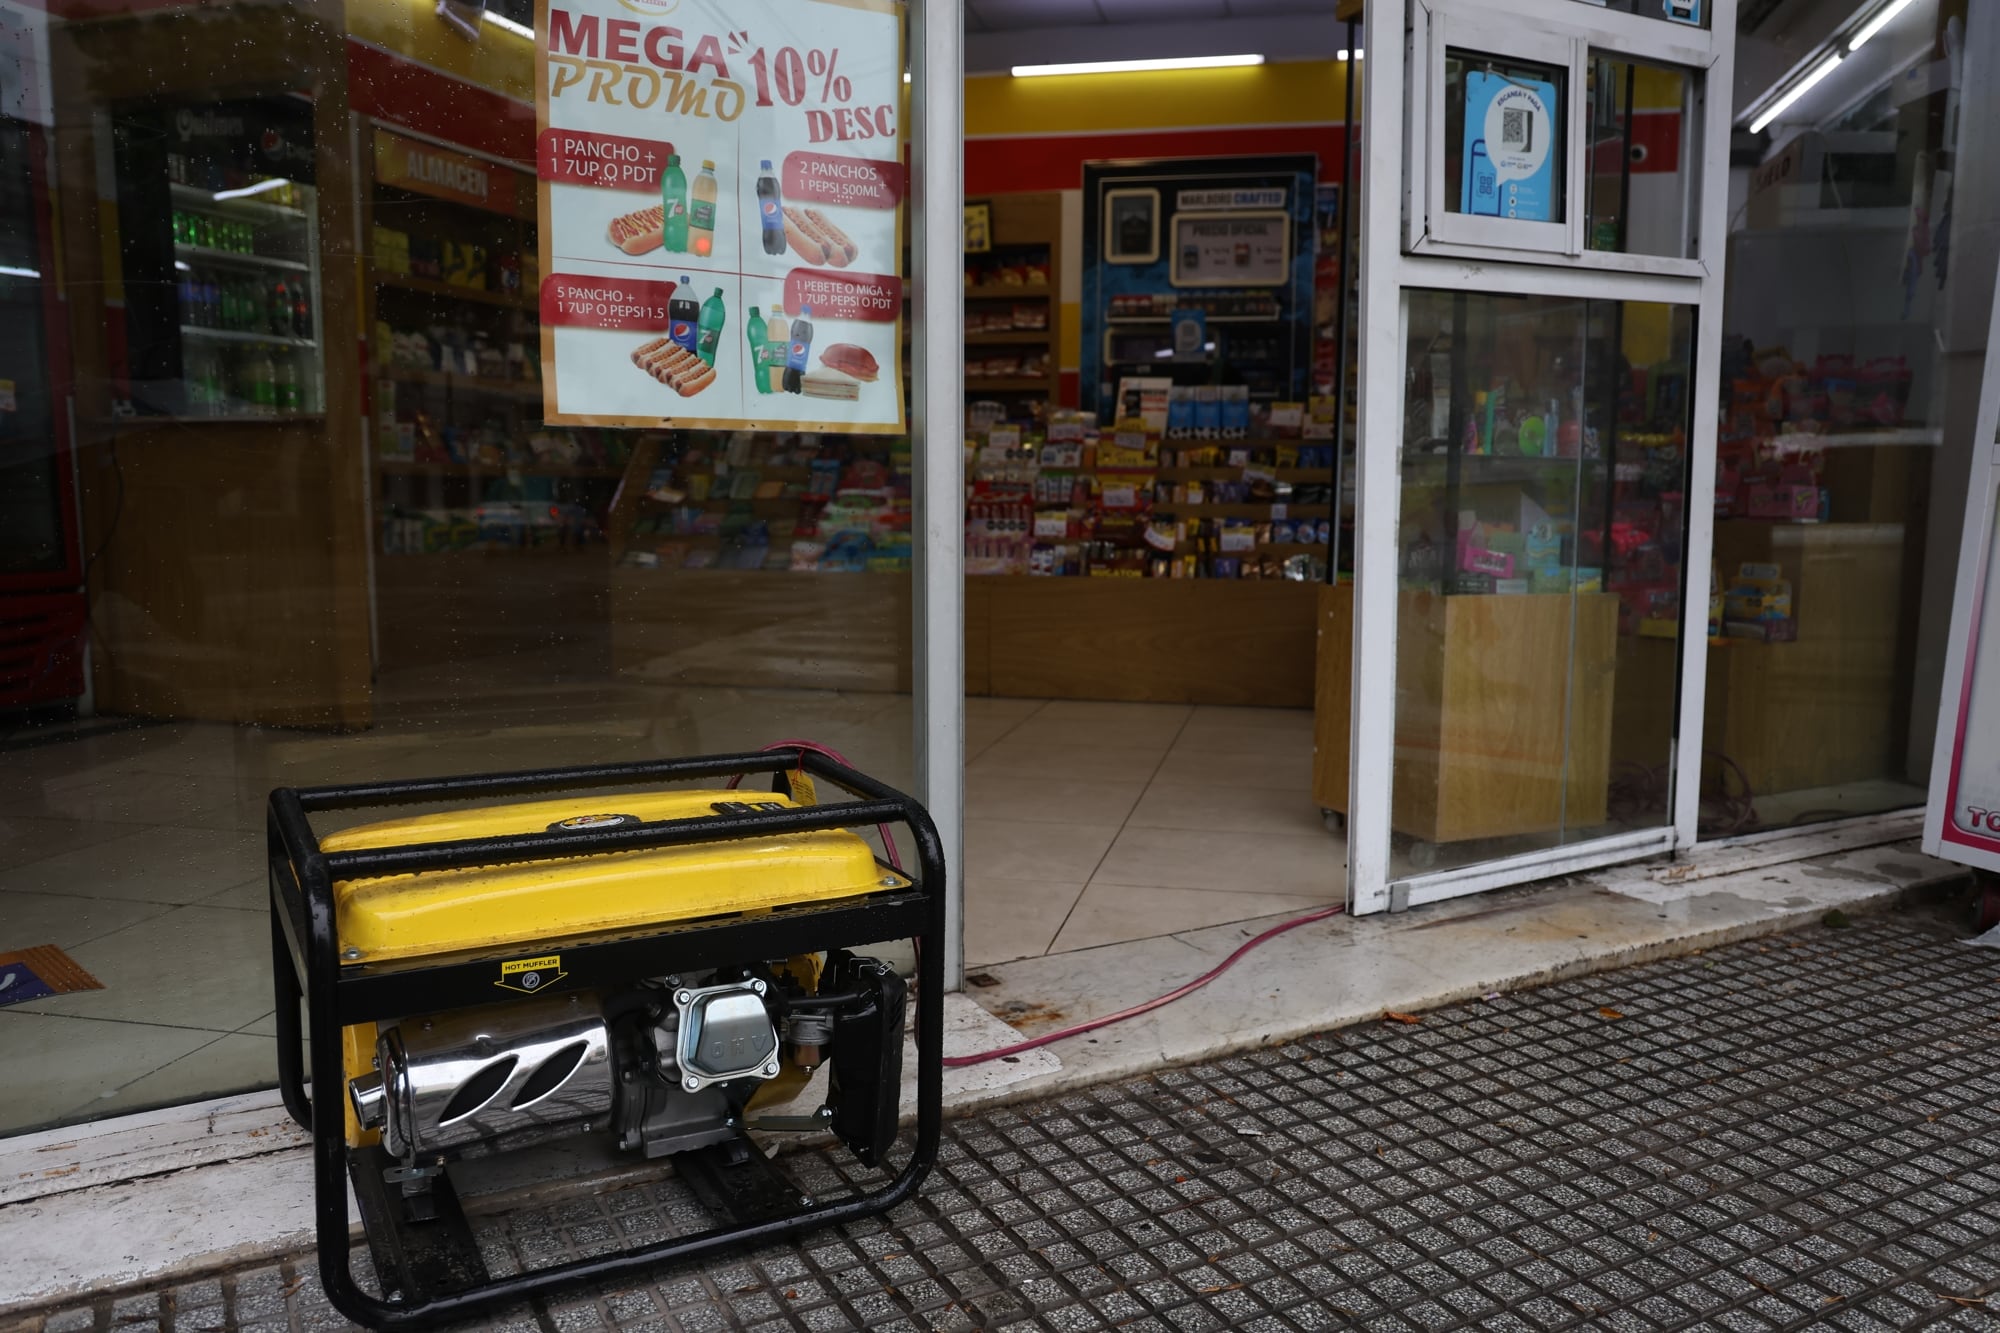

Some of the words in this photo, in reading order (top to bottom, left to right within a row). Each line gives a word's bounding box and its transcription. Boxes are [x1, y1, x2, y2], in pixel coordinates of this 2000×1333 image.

[549, 9, 730, 79] MEGA
[748, 46, 852, 107] 10%
[548, 55, 745, 122] PROMO
[804, 104, 896, 143] DESC
[550, 137, 557, 153] 1
[564, 138, 640, 162] PANCHO
[407, 150, 489, 199] ALMACEN
[551, 157, 558, 173] 1
[565, 159, 600, 177] 7UP
[623, 165, 657, 184] PDT
[799, 161, 808, 174] 2
[811, 161, 878, 181] PANCHOS
[799, 179, 805, 191] 1
[808, 179, 840, 194] PEPSI
[842, 183, 881, 198] 500ML
[1234, 191, 1282, 205] CRAFTED
[557, 286, 565, 298] 5
[568, 287, 623, 302] PANCHO
[796, 279, 801, 290] 1
[804, 280, 843, 294] PEBETE
[844, 283, 854, 294] O
[856, 284, 884, 297] MIGA
[557, 301, 563, 313] 1
[568, 301, 594, 315] 7UP
[596, 303, 607, 316] O
[610, 304, 644, 318] PEPSI
[647, 307, 665, 319] 1.5
[797, 293, 802, 303] 1
[830, 295, 859, 307] PEPSI
[861, 296, 871, 308] O
[872, 298, 892, 310] PDT
[505, 963, 521, 971] HOT
[523, 958, 557, 969] MUFFLER
